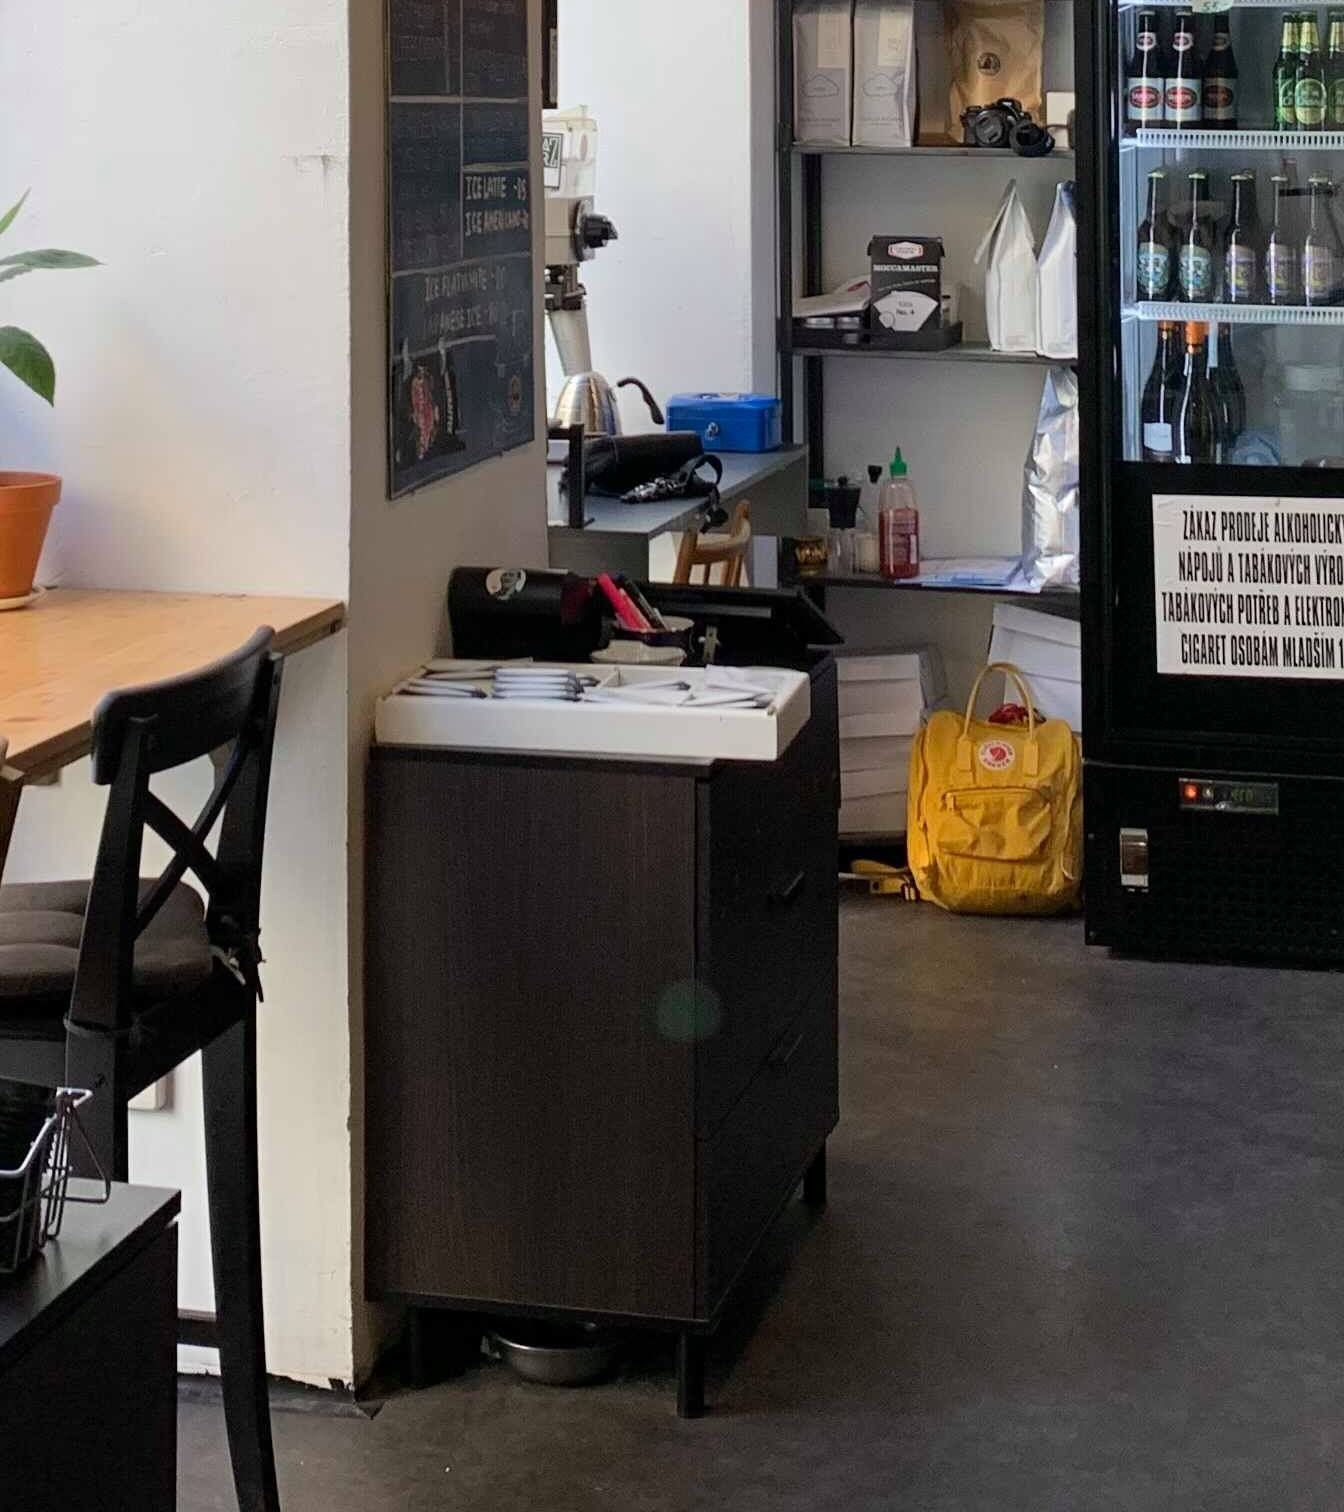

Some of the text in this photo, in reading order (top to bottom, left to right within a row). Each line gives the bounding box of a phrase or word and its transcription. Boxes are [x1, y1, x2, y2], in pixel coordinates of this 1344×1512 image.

[1182, 504, 1217, 541] ZÁKAZ
[1221, 512, 1270, 543] PRODEJE
[1178, 545, 1223, 583] NÁPOJŮ
[1227, 552, 1235, 583] A
[1238, 547, 1312, 586] TABÁKOVÝCH
[1161, 586, 1234, 625] TABÁKOVÝCH
[1238, 588, 1280, 626] POTŘEB
[1283, 595, 1292, 626] A
[1180, 633, 1227, 666] CIGARET
[1230, 629, 1279, 667] OSOBÁM
[1282, 631, 1336, 669] MLADŠÍM
